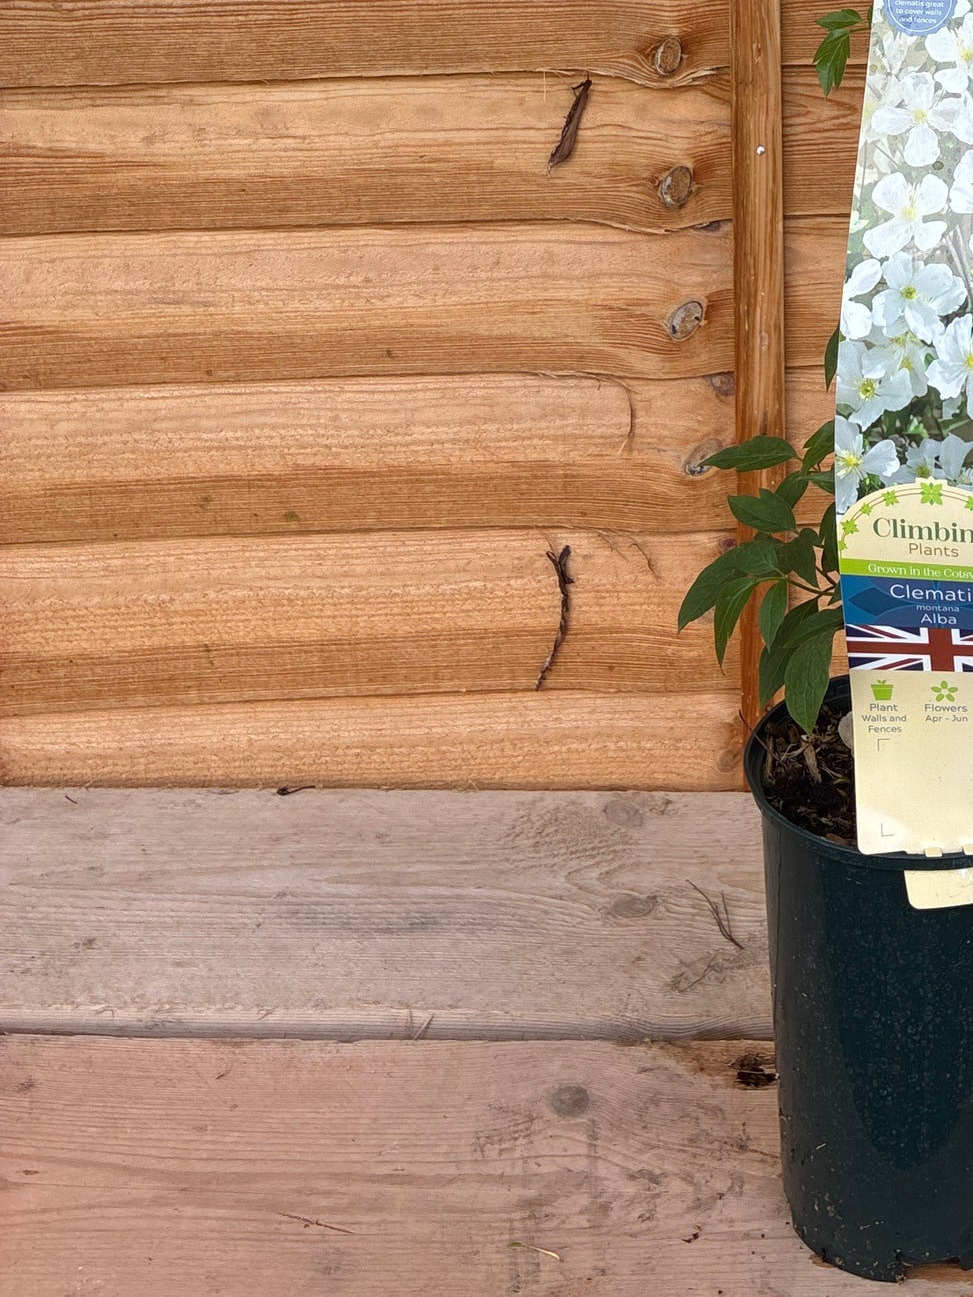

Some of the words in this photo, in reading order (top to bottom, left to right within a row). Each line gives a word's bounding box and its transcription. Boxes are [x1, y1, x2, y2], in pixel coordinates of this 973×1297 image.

[894, 0, 924, 7] clematis
[908, 542, 960, 558] Plants
[867, 563, 907, 576] Grown
[909, 565, 921, 576] in
[923, 567, 941, 578] the
[916, 605, 959, 613] montana
[920, 613, 957, 625] Alba
[869, 703, 898, 712] Plant
[924, 703, 968, 713] Flowers
[861, 714, 887, 722] Walls
[889, 714, 907, 722] and
[925, 714, 942, 724] Apr
[951, 714, 968, 722] Jun
[868, 725, 902, 733] Fences
